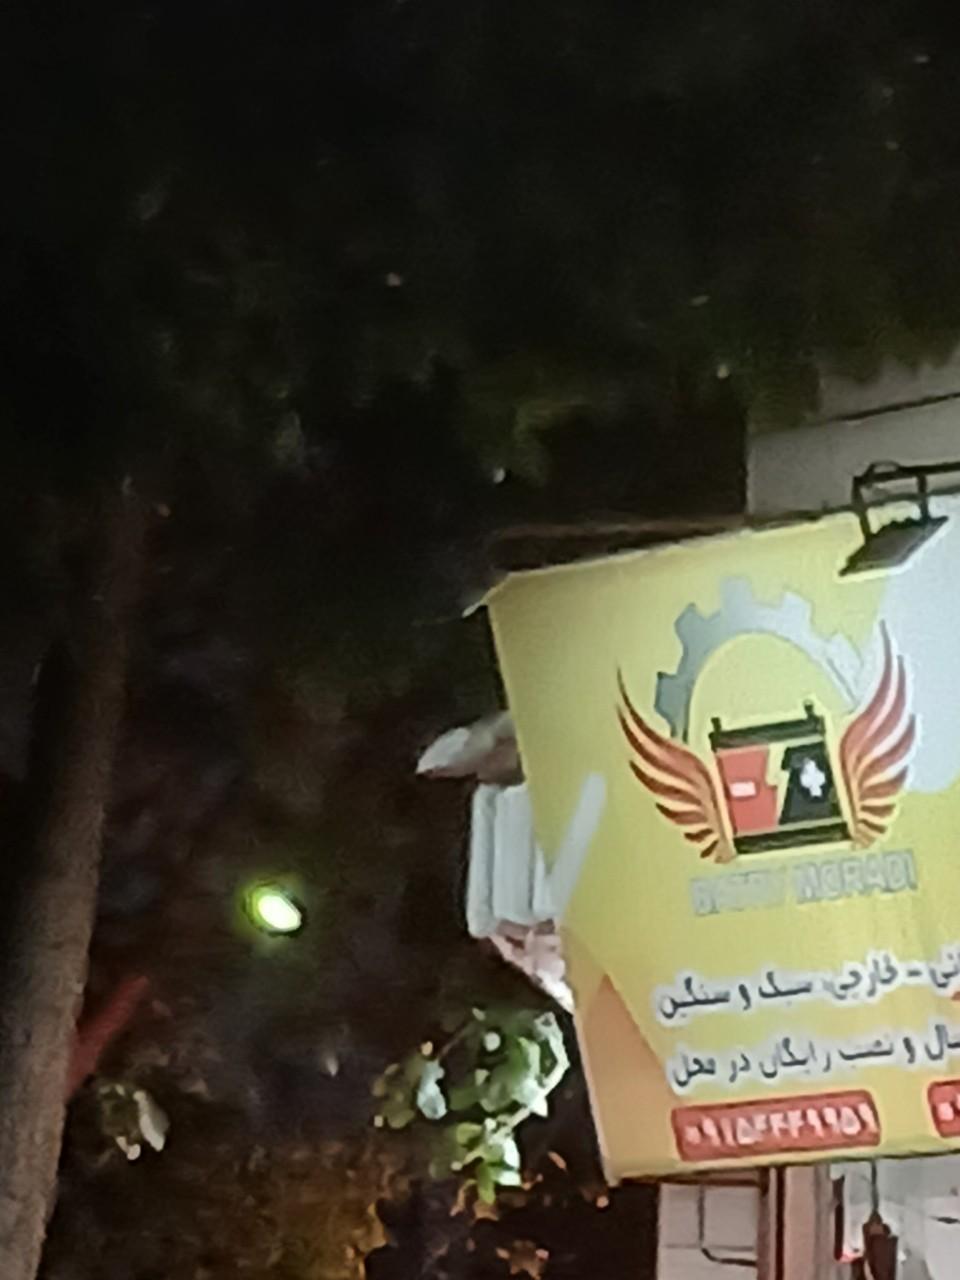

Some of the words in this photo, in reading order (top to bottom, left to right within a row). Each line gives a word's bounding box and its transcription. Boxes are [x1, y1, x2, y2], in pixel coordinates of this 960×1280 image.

[758, 970, 813, 1007] سبک
[824, 954, 899, 1000] خارجی
[659, 976, 731, 1020] سنگین
[737, 983, 752, 1011] و
[728, 1052, 751, 1083] در
[758, 1037, 832, 1079] رایگان
[902, 1036, 916, 1065] و
[672, 1051, 717, 1088] محل
